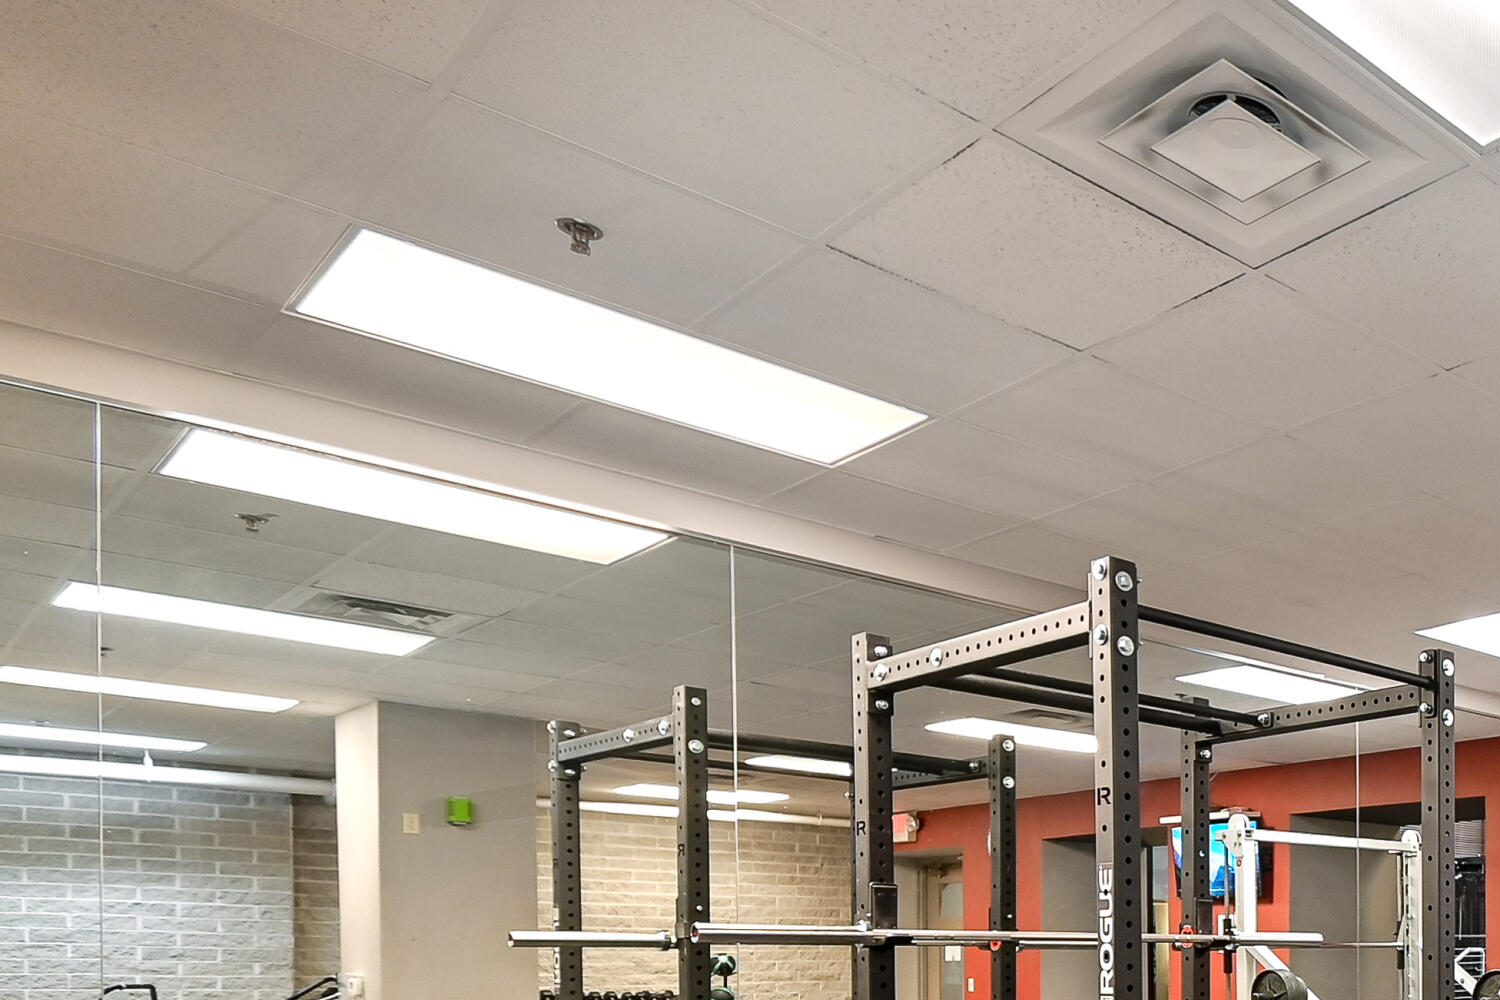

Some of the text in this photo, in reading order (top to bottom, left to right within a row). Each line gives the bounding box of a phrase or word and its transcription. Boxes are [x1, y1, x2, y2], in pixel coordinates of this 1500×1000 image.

[1097, 787, 1111, 806] R
[856, 821, 866, 836] R
[1098, 867, 1114, 994] ROGUE
